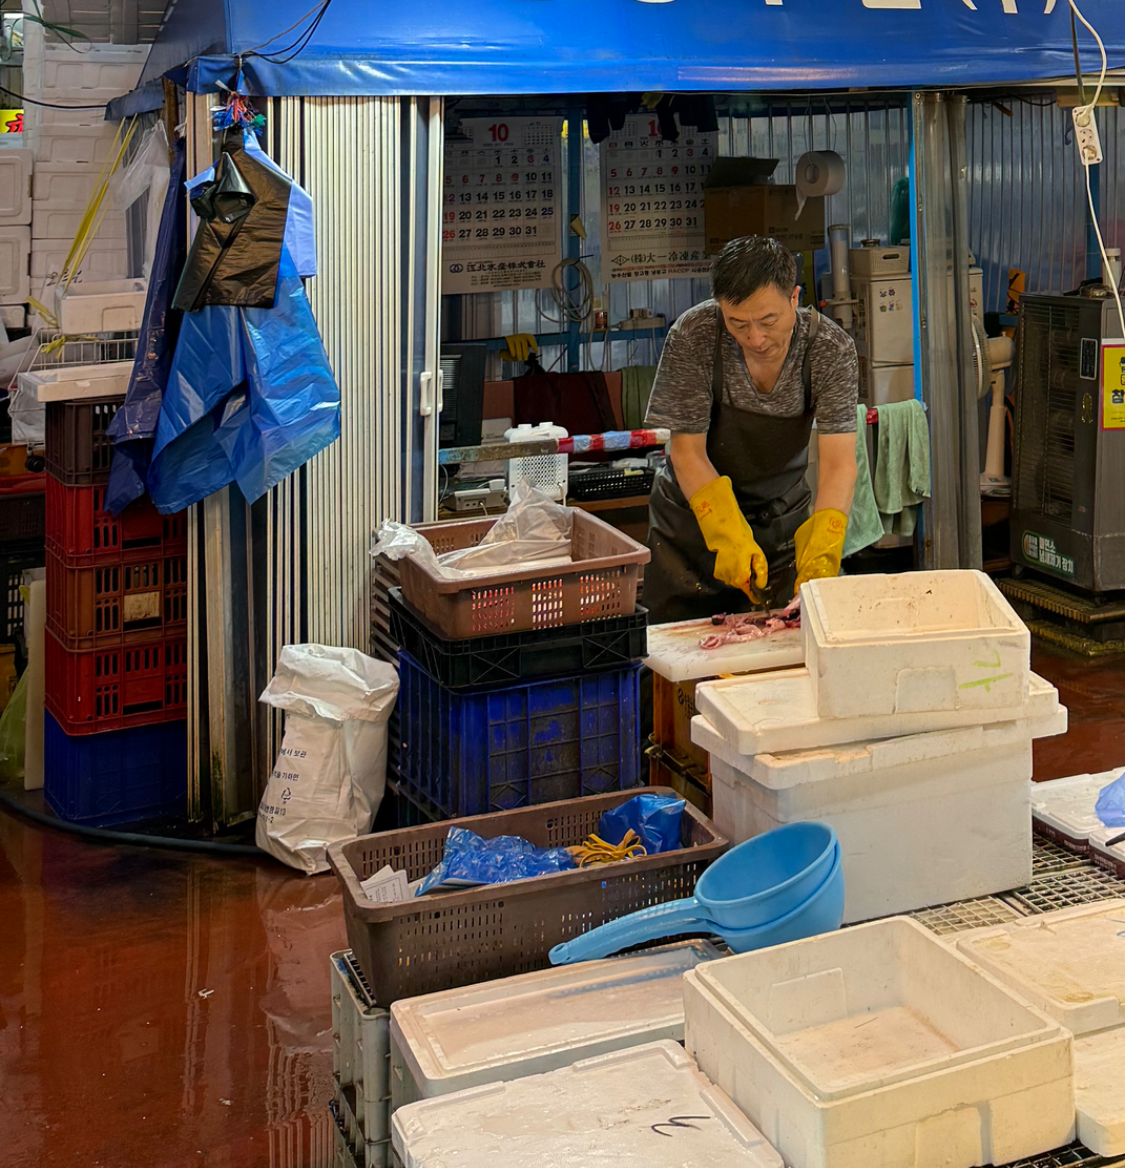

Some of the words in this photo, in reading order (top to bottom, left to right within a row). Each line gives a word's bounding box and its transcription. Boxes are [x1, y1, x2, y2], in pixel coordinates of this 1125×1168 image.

[488, 123, 509, 142] 10
[495, 156, 500, 164] 1
[511, 156, 518, 164] 2
[543, 154, 549, 163] 4
[658, 150, 662, 158] 1
[672, 149, 678, 157] 2
[687, 148, 693, 157] 3
[702, 148, 708, 156] 4
[611, 169, 617, 177] 5
[626, 168, 632, 176] 6
[641, 167, 647, 176] 7
[656, 167, 662, 175] 8
[672, 166, 678, 174] 9
[685, 166, 696, 174] 10
[700, 165, 710, 174] 11
[462, 175, 469, 184] 6
[479, 174, 485, 183] 7
[496, 174, 502, 182] 8
[525, 172, 537, 181] 10
[541, 172, 552, 180] 11
[609, 187, 620, 195] 12
[624, 186, 635, 194] 13
[640, 185, 650, 193] 14
[655, 184, 665, 192] 15
[670, 184, 681, 192] 16
[685, 183, 696, 191] 17
[443, 193, 455, 203] 12
[460, 193, 471, 202] 13
[476, 192, 488, 201] 14
[493, 191, 505, 200] 15
[509, 191, 521, 199] 16
[525, 190, 537, 198] 17
[542, 189, 553, 198] 18
[609, 204, 620, 212] 19
[624, 203, 636, 211] 20
[640, 202, 651, 210] 21
[654, 201, 667, 210] 22
[670, 200, 682, 209] 23
[685, 200, 697, 208] 24
[443, 212, 455, 220] 19
[459, 211, 472, 220] 20
[476, 210, 488, 219] 21
[492, 209, 505, 218] 22
[509, 209, 521, 218] 23
[525, 208, 538, 216] 24
[541, 207, 554, 216] 25
[609, 222, 621, 230] 26
[624, 220, 636, 229] 27
[639, 219, 651, 228] 28
[654, 218, 667, 227] 29
[670, 218, 682, 226] 30
[686, 217, 697, 225] 31
[443, 230, 455, 239] 26
[459, 229, 472, 238] 27
[476, 228, 489, 237] 28
[492, 227, 505, 236] 29
[509, 227, 521, 235] 30
[525, 226, 537, 235] 31
